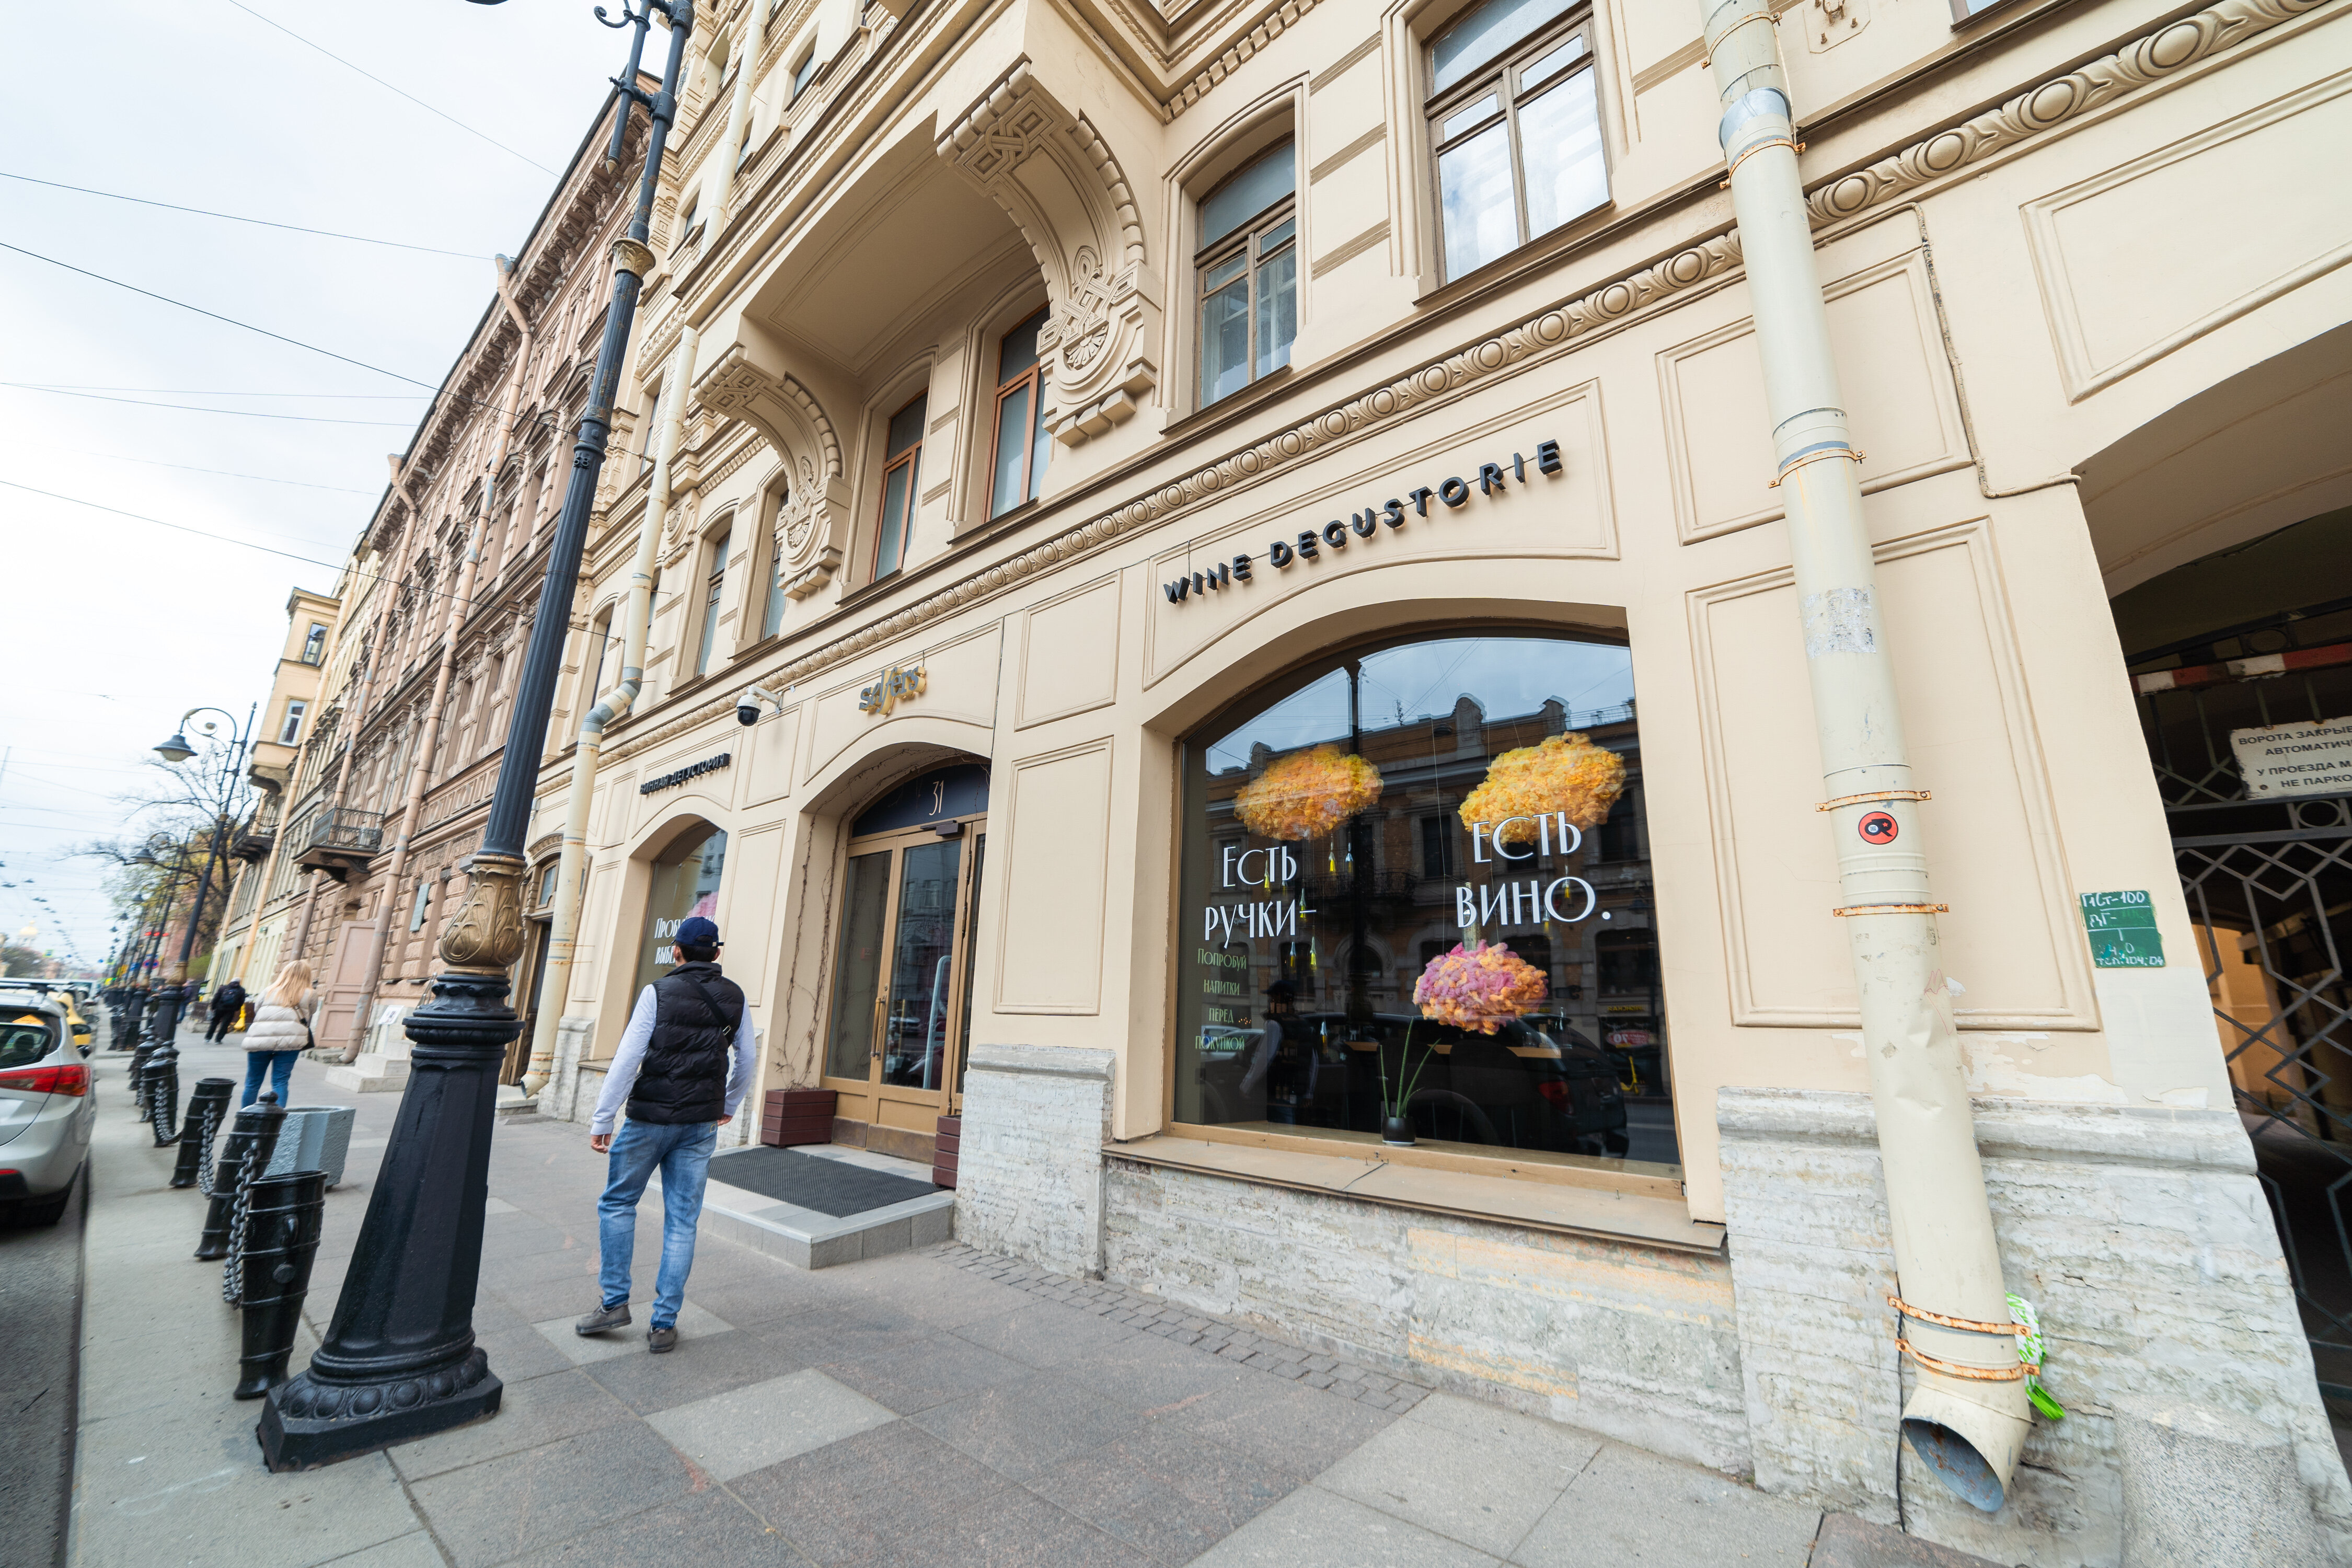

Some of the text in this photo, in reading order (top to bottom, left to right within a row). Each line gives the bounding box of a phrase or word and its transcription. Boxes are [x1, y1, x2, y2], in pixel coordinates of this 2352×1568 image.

[1163, 439, 1563, 604] WINE DEGUSTORIE
[859, 666, 926, 715] selfers
[2239, 733, 2293, 745] ВОРОТА
[2265, 740, 2352, 755] АВТОМАТИЧ
[640, 753, 730, 794] ВИННАЯ ДЕГУСТОРИЯ
[2269, 762, 2336, 775] ПРОЕЗДА
[929, 780, 944, 816] 31
[1456, 876, 1611, 928] ВИНО.
